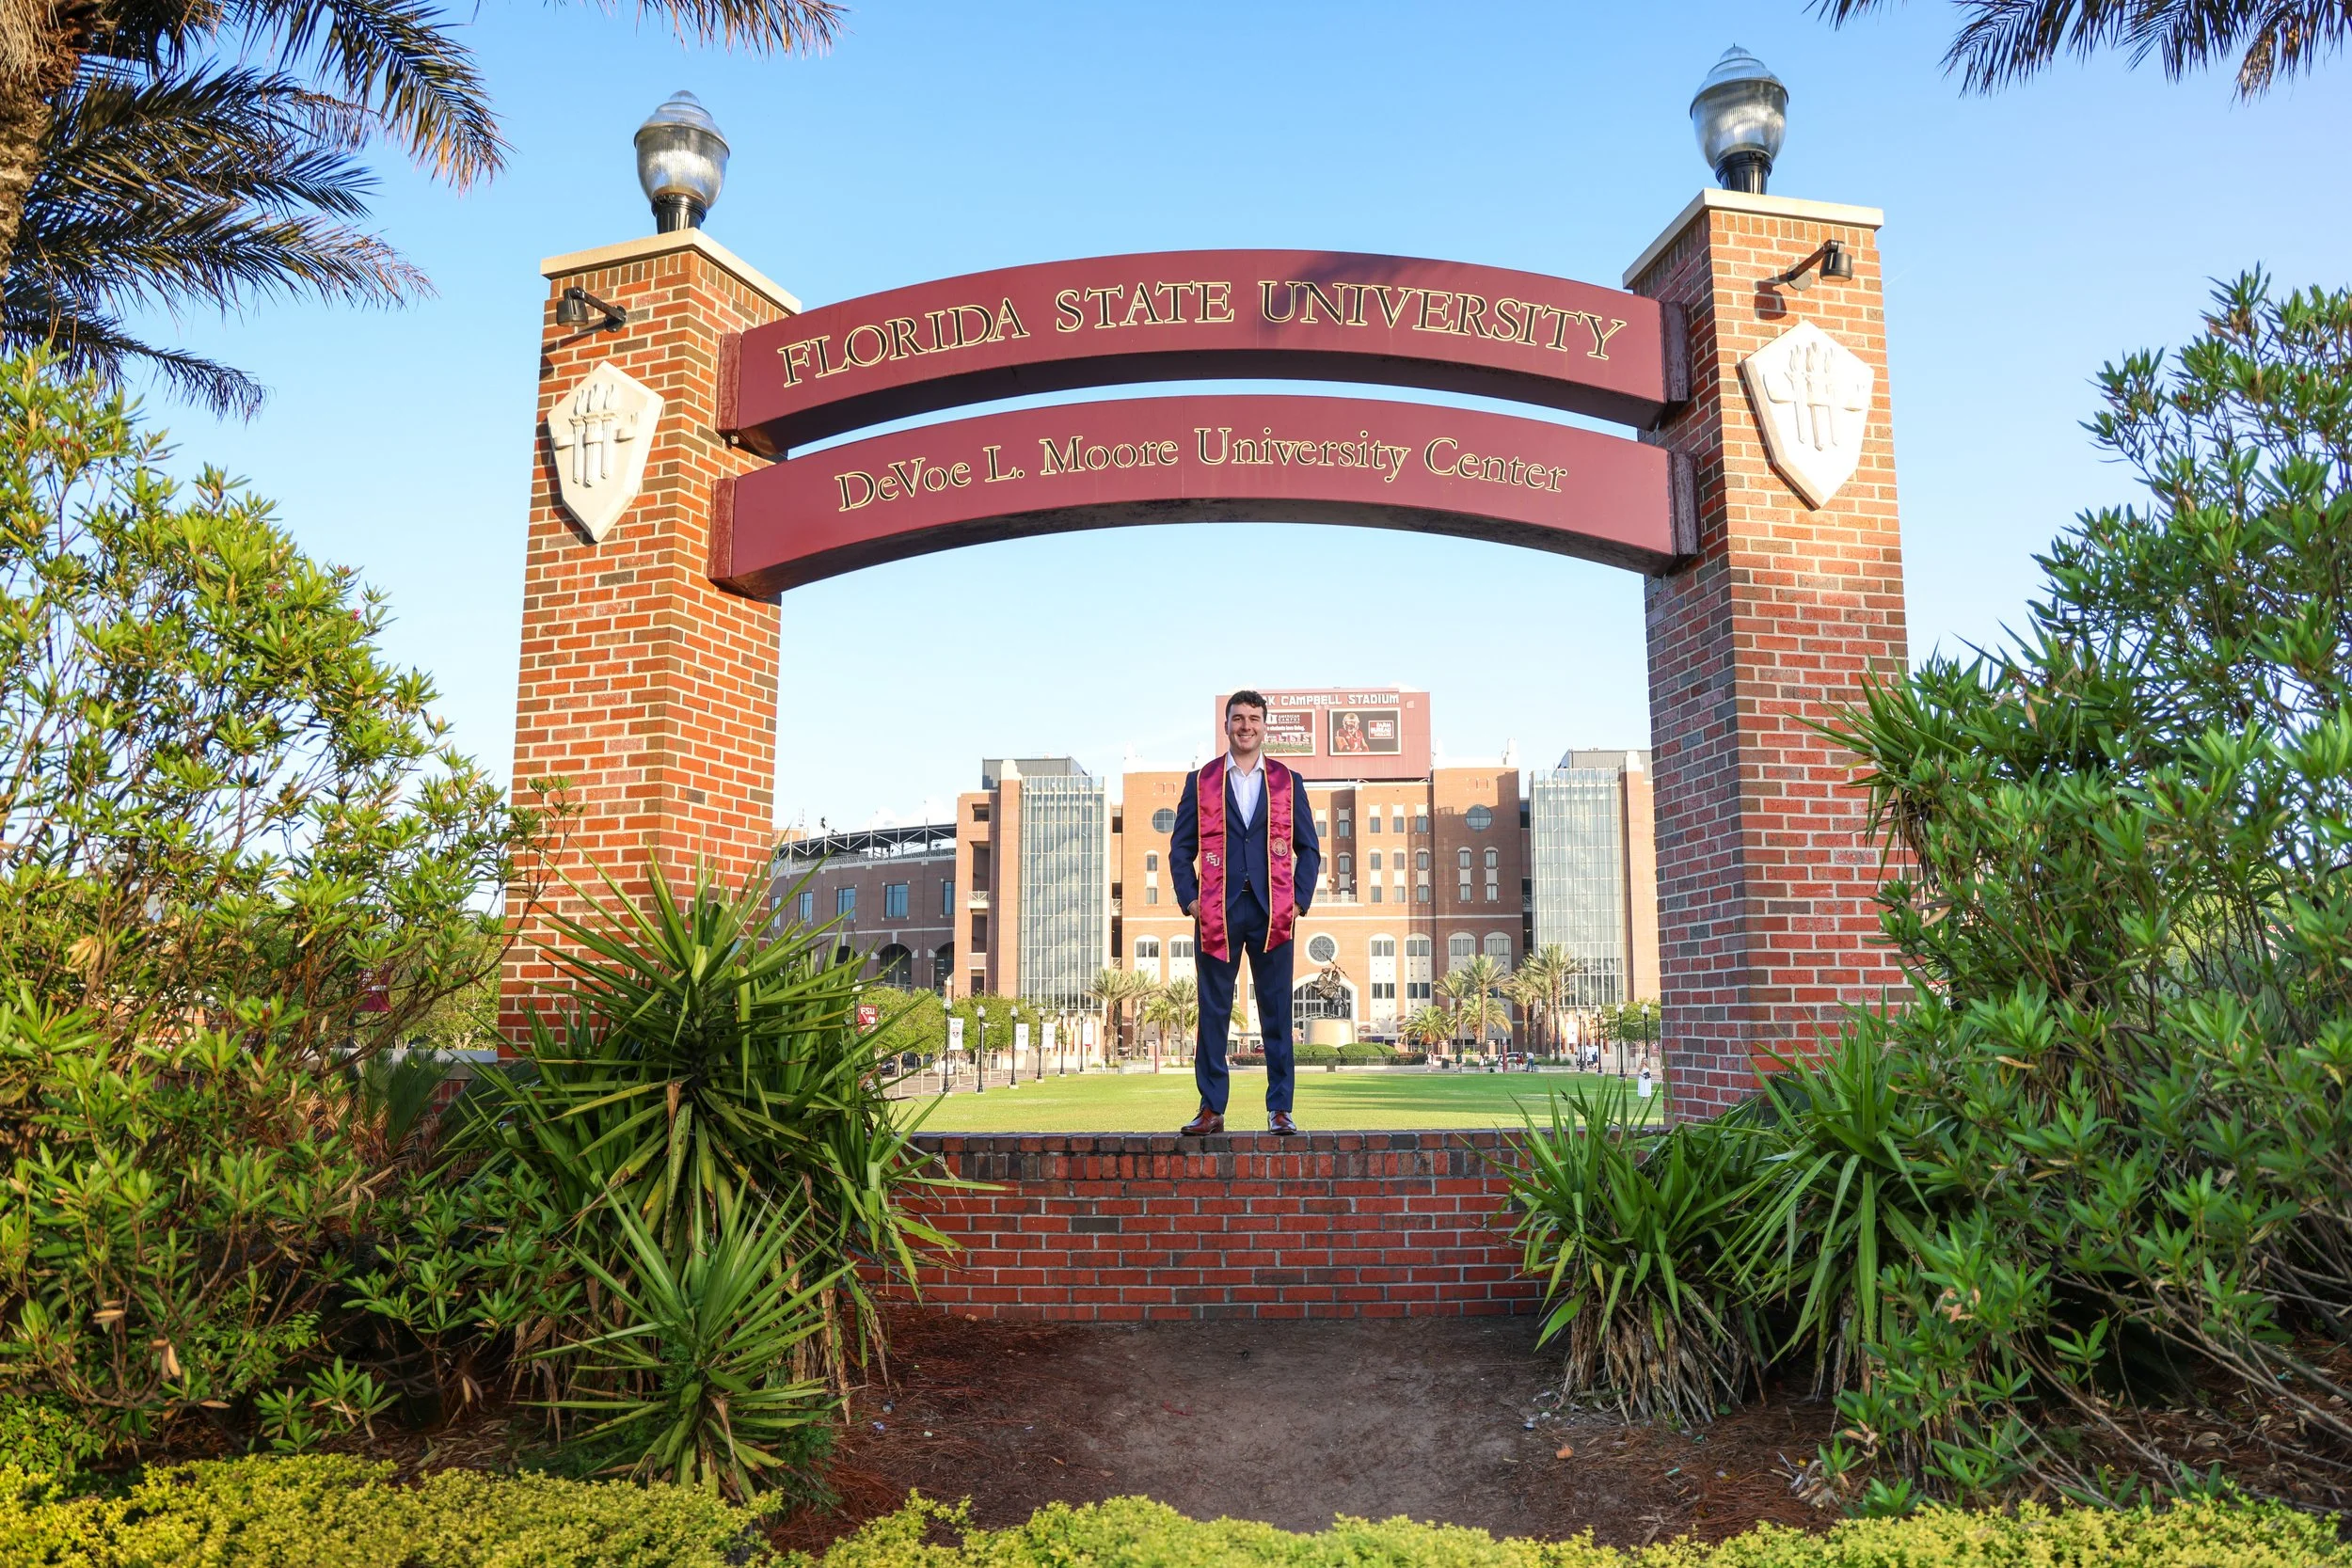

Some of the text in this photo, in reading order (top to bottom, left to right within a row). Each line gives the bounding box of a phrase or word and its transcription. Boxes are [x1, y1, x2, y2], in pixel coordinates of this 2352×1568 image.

[777, 280, 1627, 388] FLORIDA STATE UNIVERSITY
[834, 427, 1568, 513] DeVoe L. Moore University Center
[1280, 694, 1343, 705] CAMPBELL
[1347, 694, 1400, 705] STADIUM
[1205, 851, 1220, 867] FSU
[860, 1006, 875, 1015] FSU
